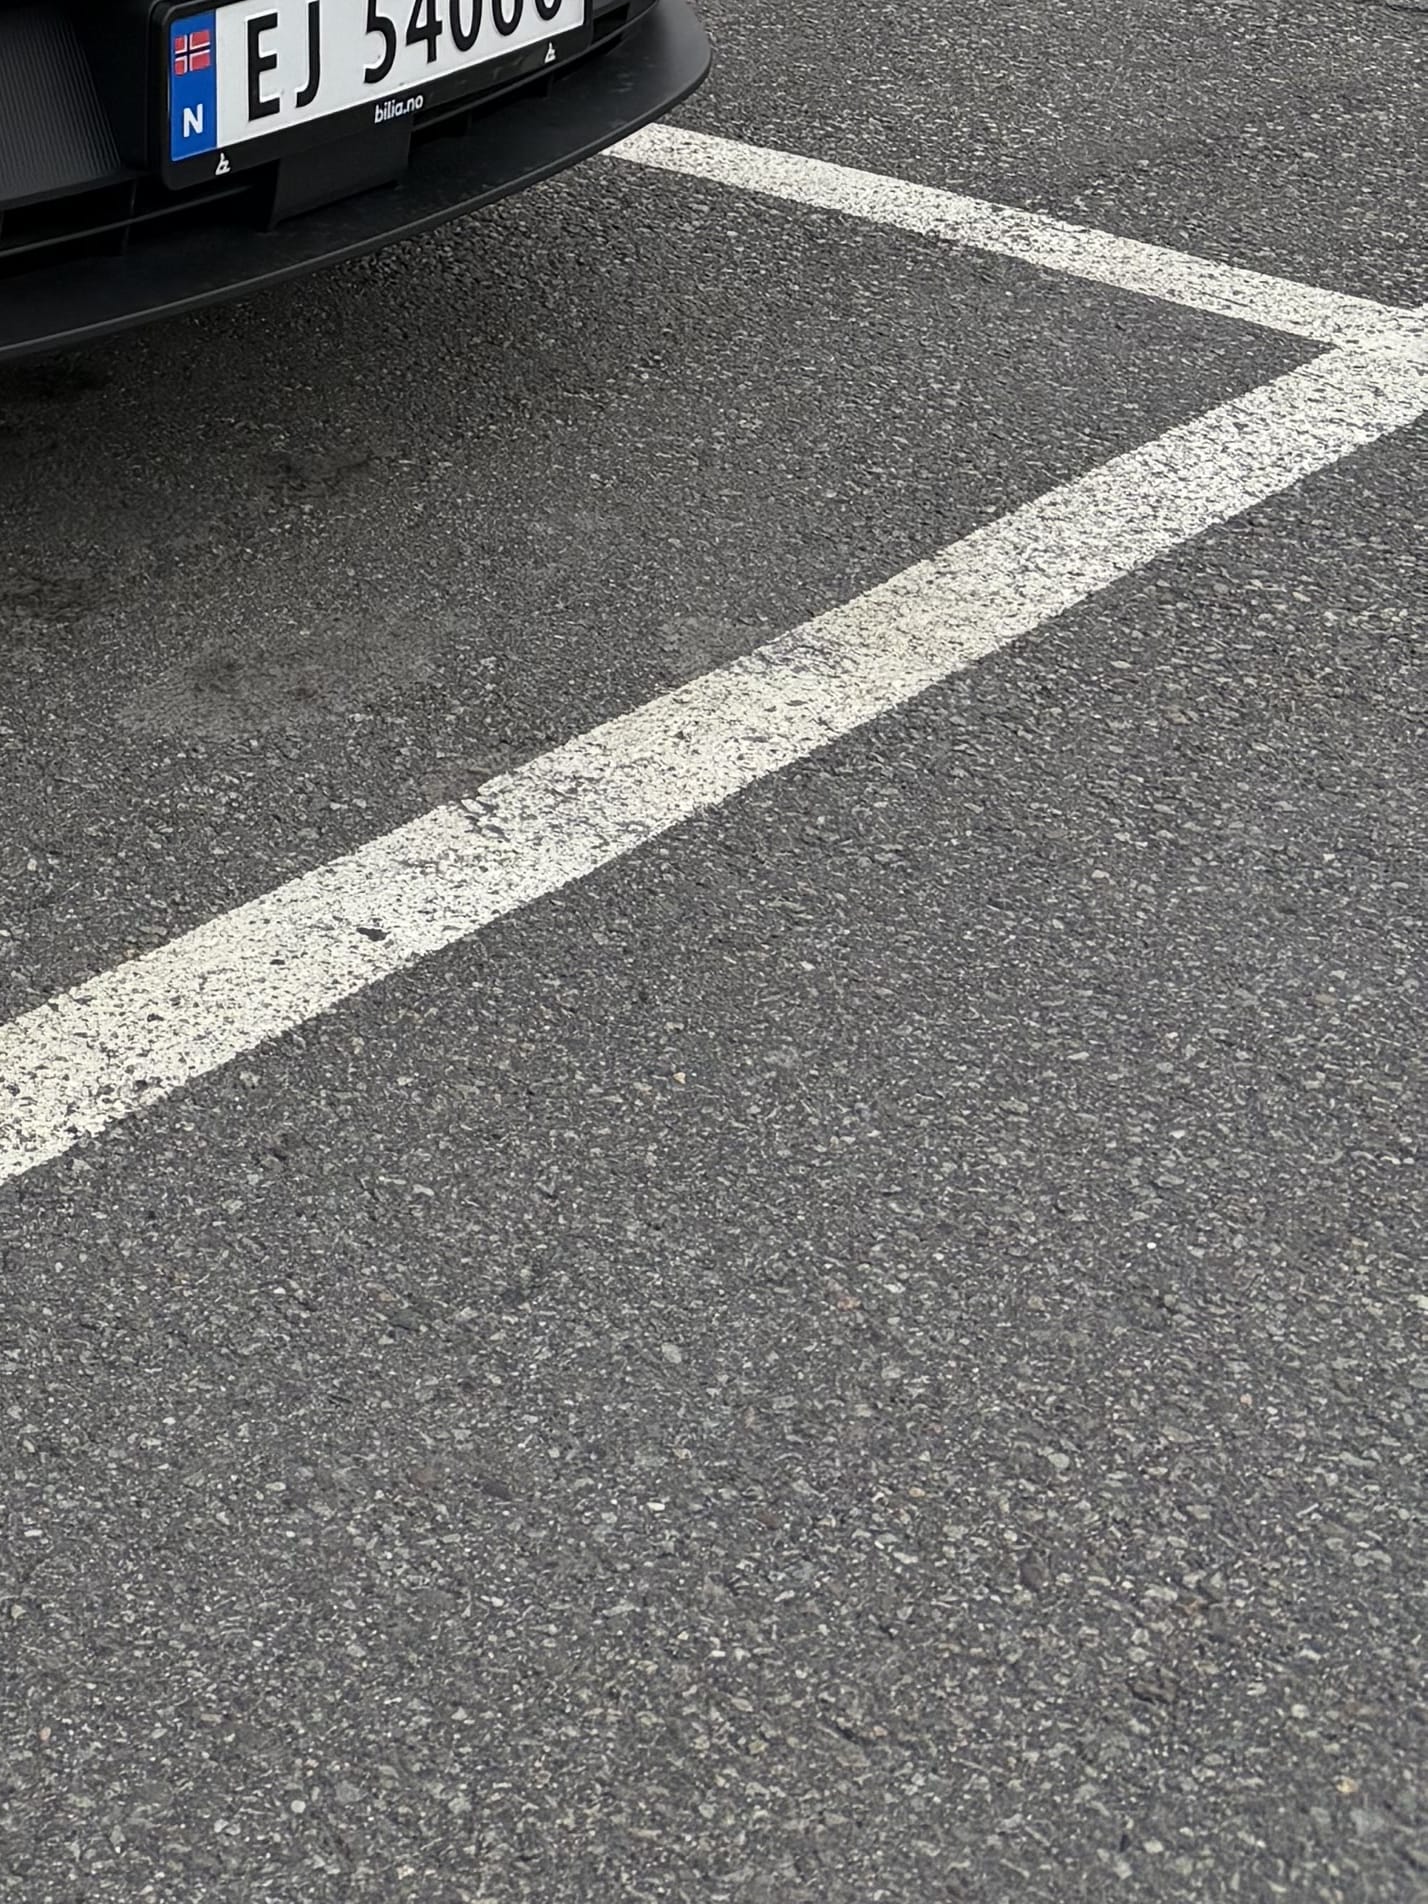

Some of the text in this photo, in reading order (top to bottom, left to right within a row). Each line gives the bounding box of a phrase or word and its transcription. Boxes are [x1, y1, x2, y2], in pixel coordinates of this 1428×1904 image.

[247, 0, 322, 122] EJ
[183, 103, 204, 138] N
[373, 94, 424, 124] bilia.no
